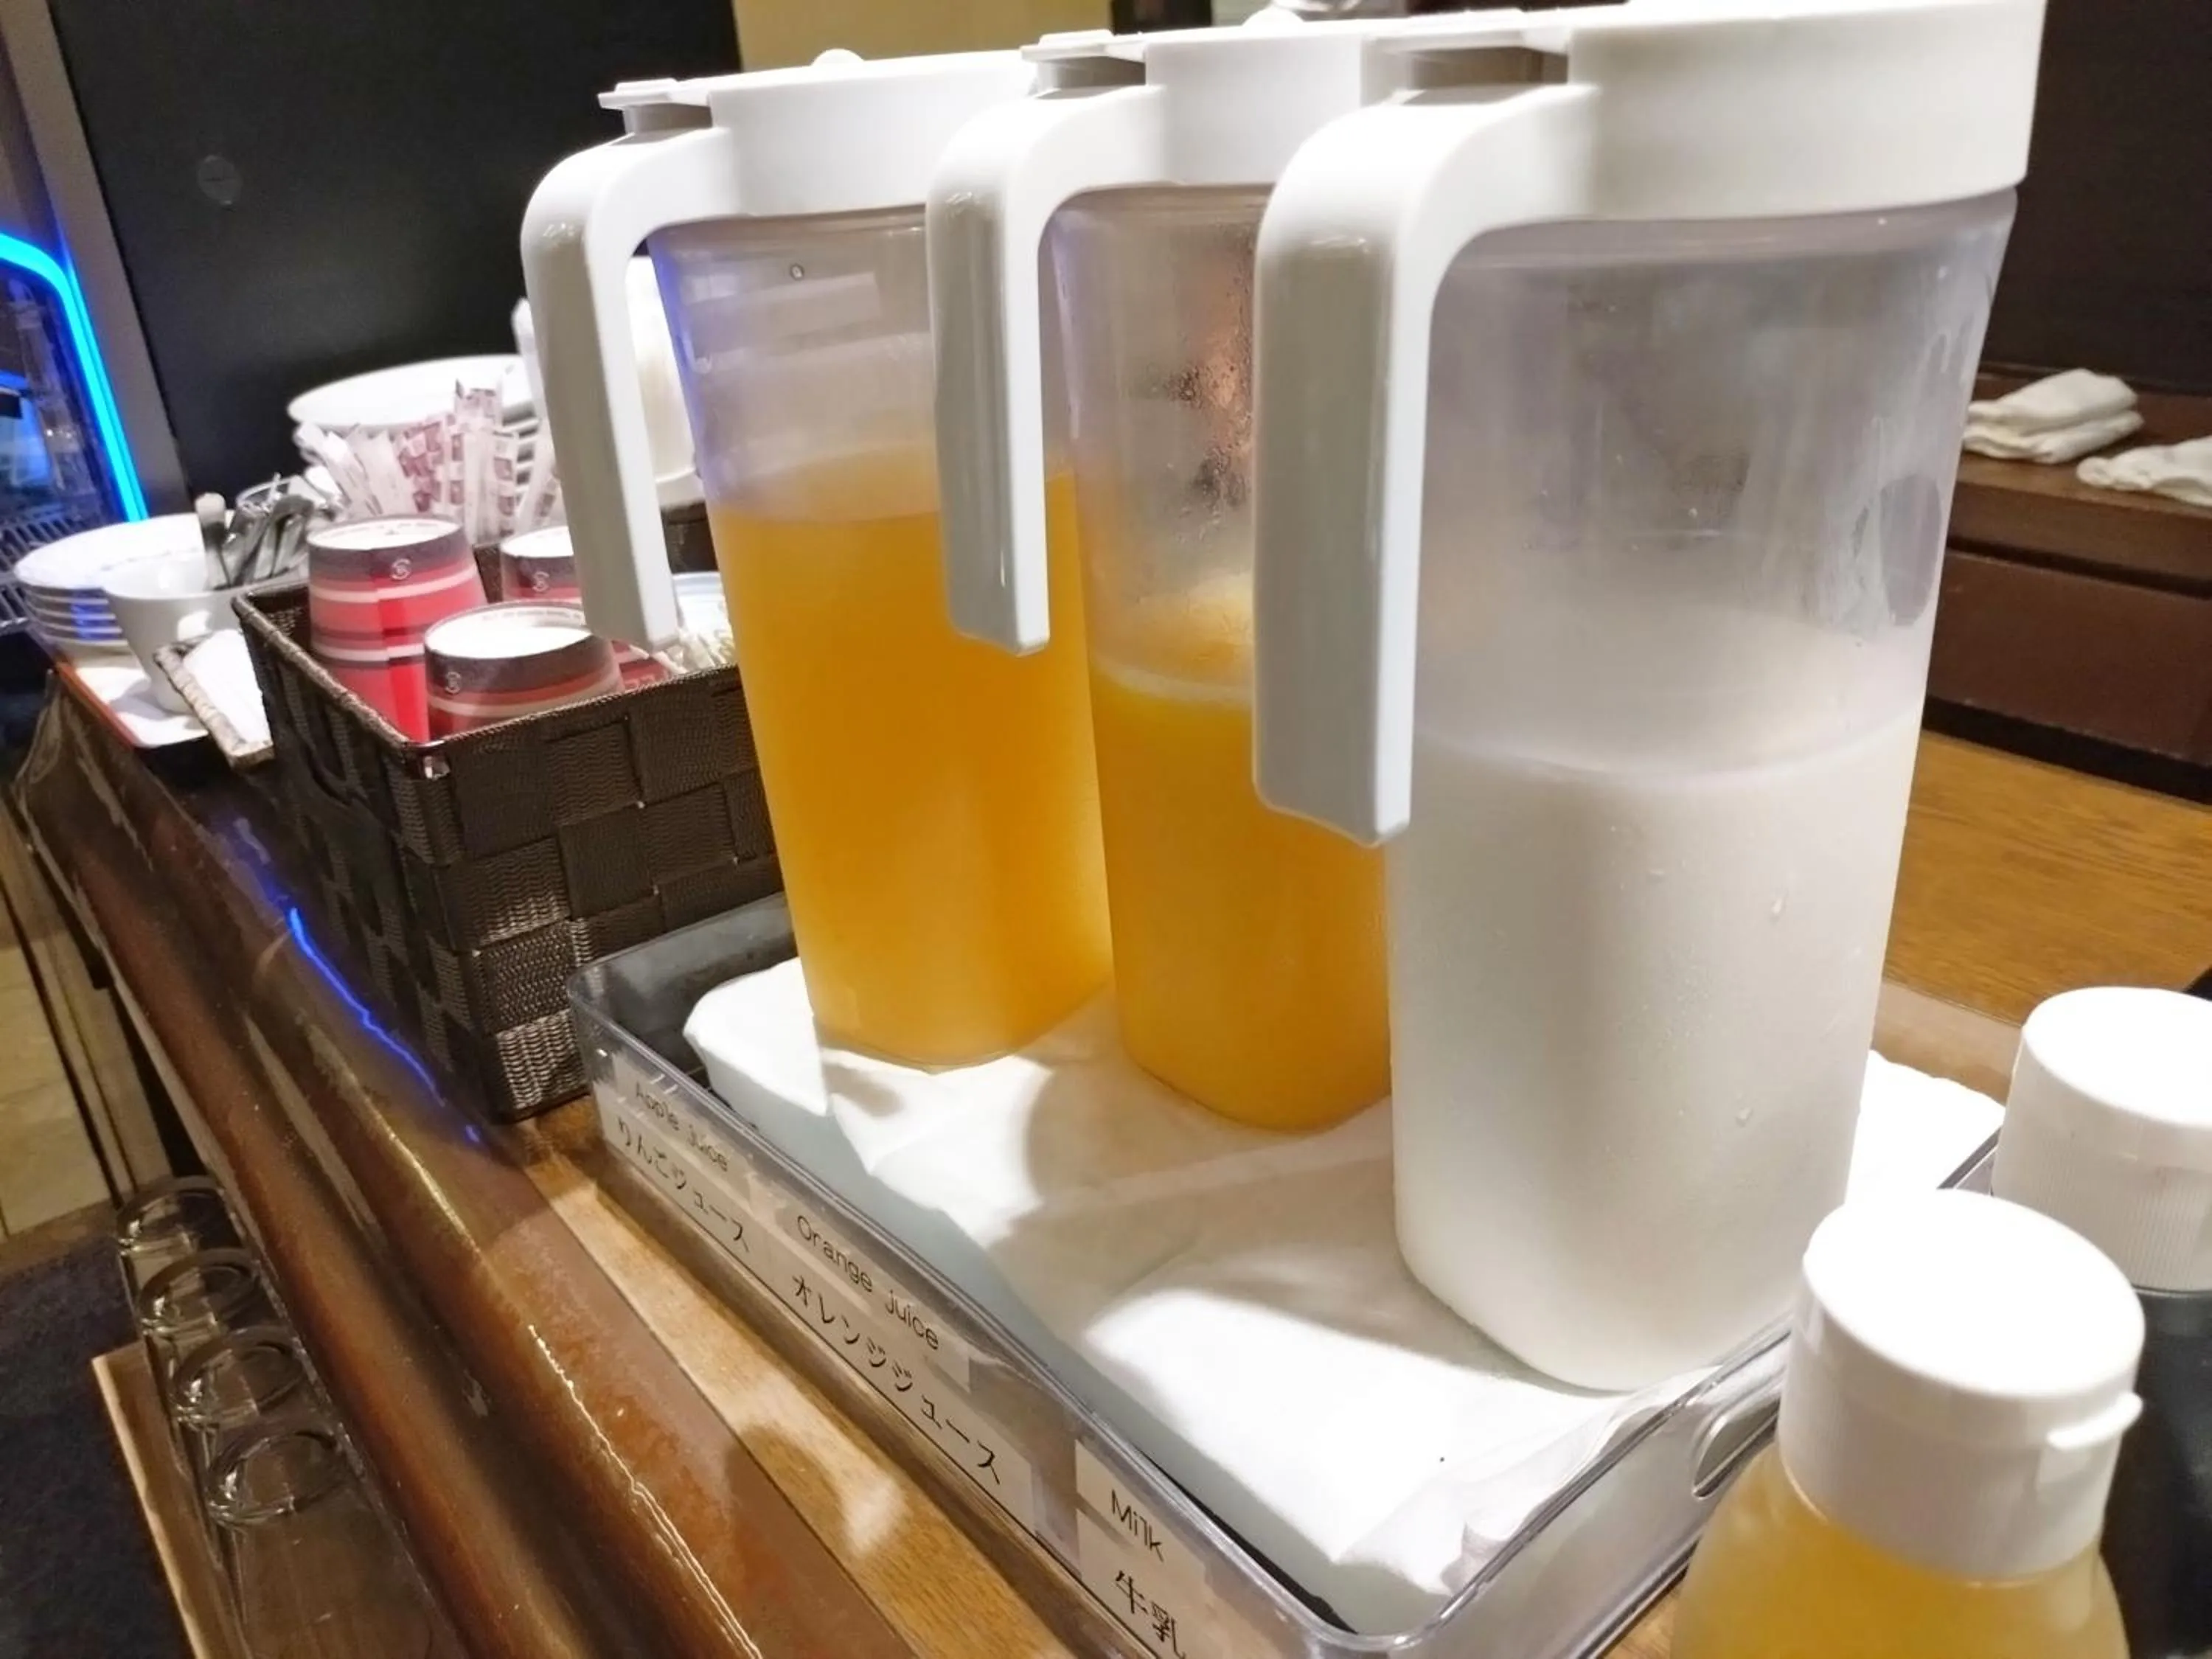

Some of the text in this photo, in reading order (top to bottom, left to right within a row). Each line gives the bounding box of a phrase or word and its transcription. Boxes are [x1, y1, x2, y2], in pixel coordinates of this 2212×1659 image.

[618, 1116, 750, 1253] りんごジュース
[796, 1214, 939, 1350] Orange juice
[792, 1274, 1001, 1485] オレンジジュース
[1111, 1488, 1164, 1562] Milk
[1115, 1569, 1186, 1659] 牛乳
